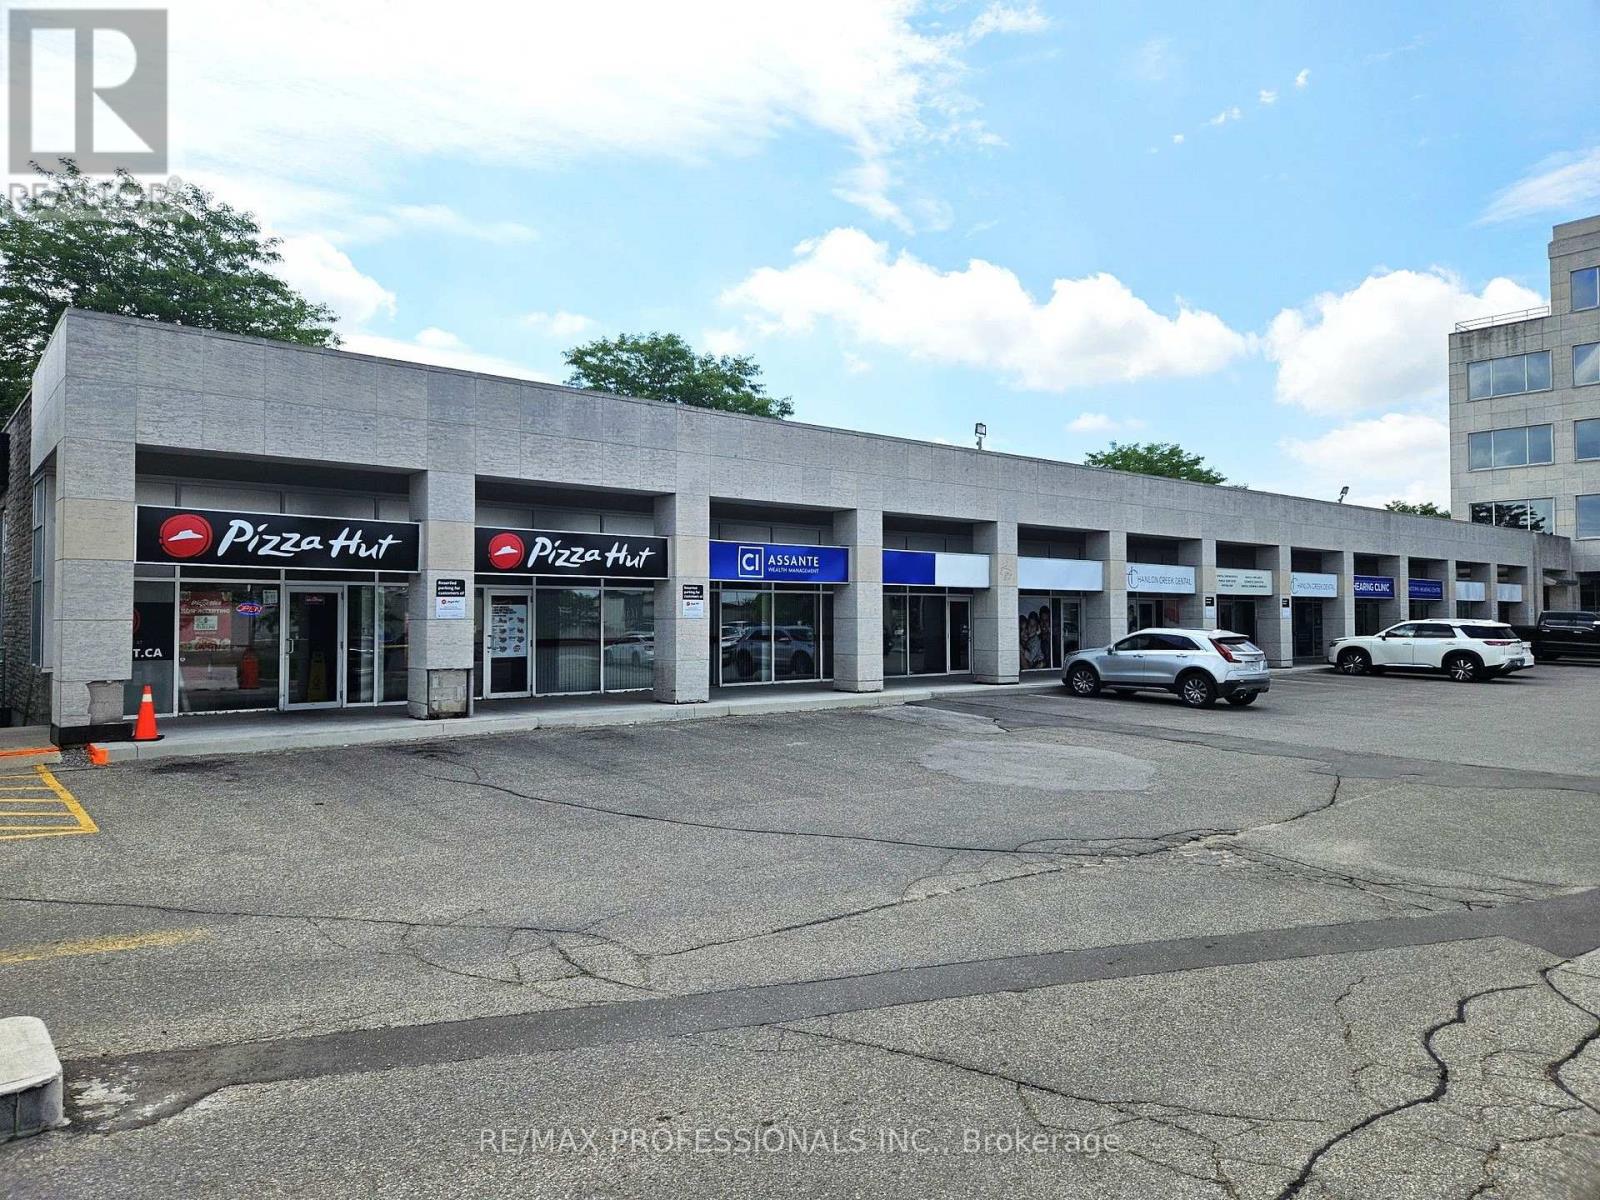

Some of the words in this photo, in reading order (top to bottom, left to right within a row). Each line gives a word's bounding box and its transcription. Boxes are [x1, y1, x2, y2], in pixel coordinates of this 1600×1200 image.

[217, 519, 323, 557] Pizza
[328, 527, 403, 560] Hut
[527, 536, 601, 568] Pizza
[605, 541, 657, 569] Hut
[768, 554, 819, 567] ASSANTE
[742, 553, 760, 571] CI
[1374, 583, 1390, 592] CLINIC
